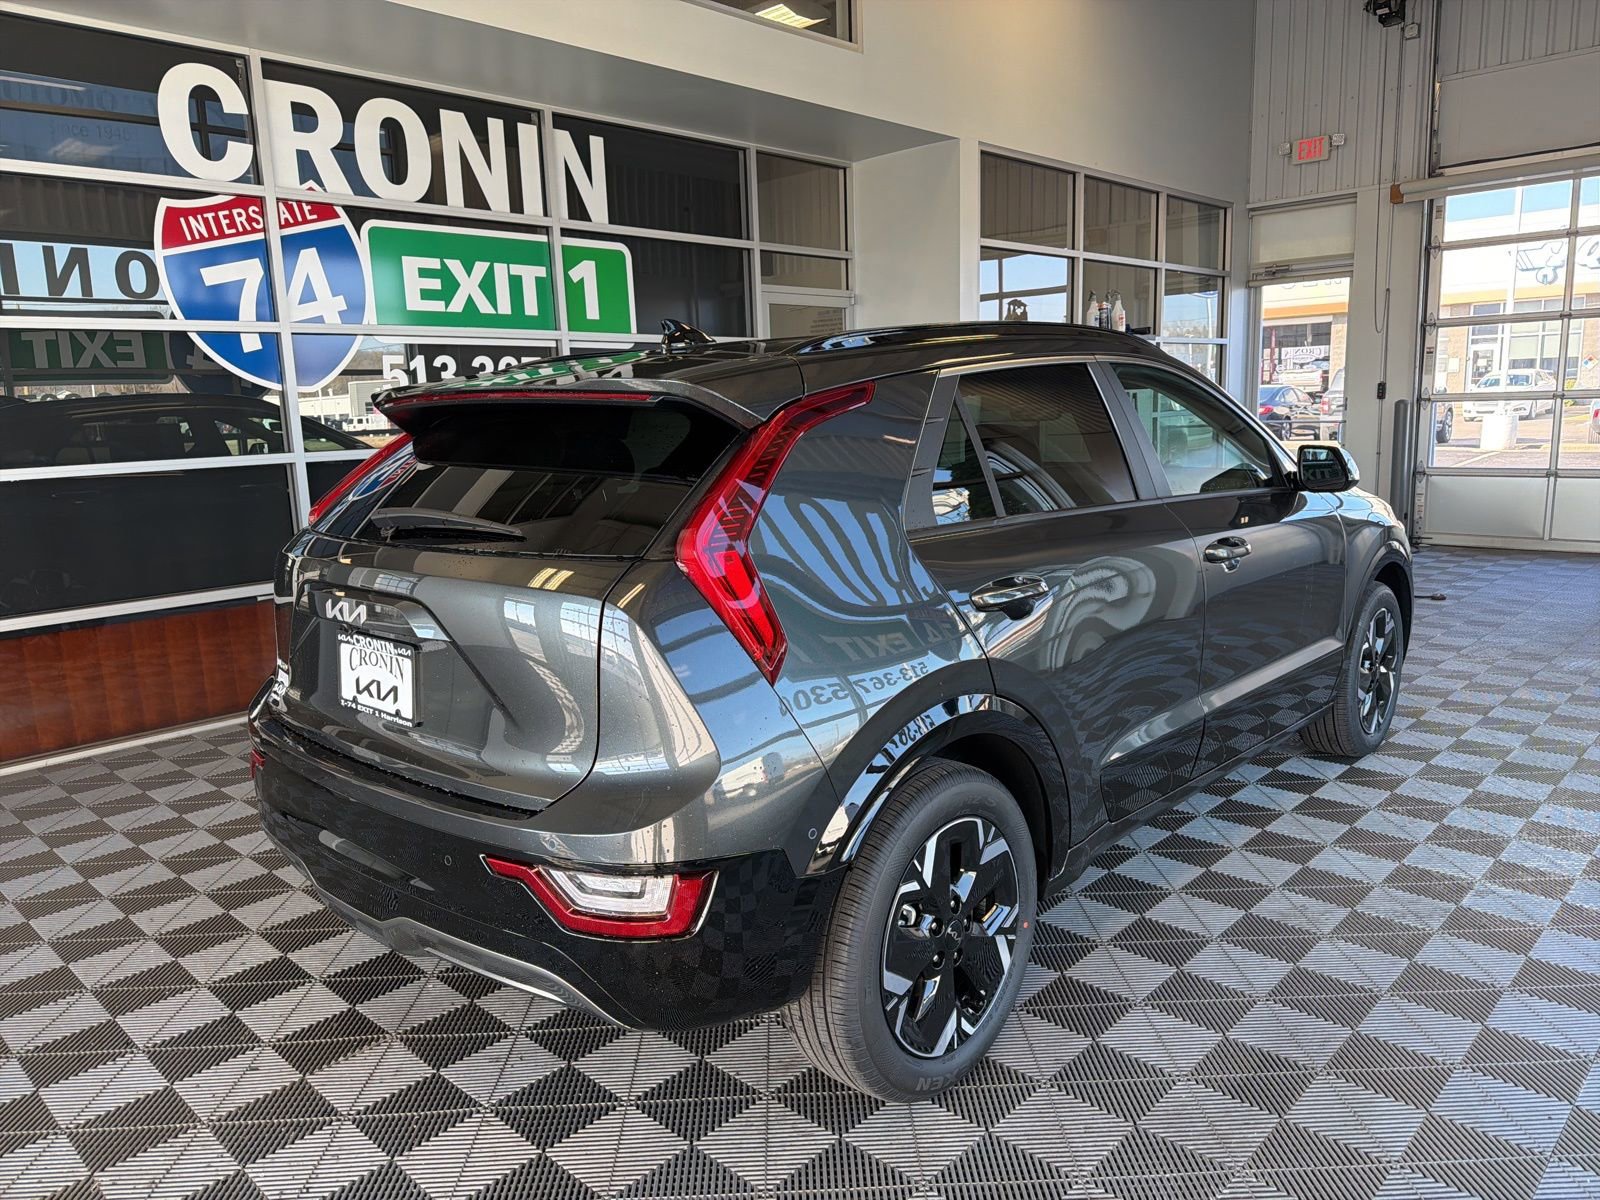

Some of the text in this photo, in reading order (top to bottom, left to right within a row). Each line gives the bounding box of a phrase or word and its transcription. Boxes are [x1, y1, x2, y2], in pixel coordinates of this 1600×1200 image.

[158, 63, 609, 224] CRONIN
[1297, 137, 1325, 161] EXIT
[180, 201, 318, 241] INTERSATE
[200, 247, 347, 353] 74
[401, 256, 600, 320] EXIT 1
[352, 634, 395, 655] CRONIN
[349, 646, 405, 684] CRONIN
[357, 704, 374, 715] EXIT
[381, 712, 413, 728] Harrison
